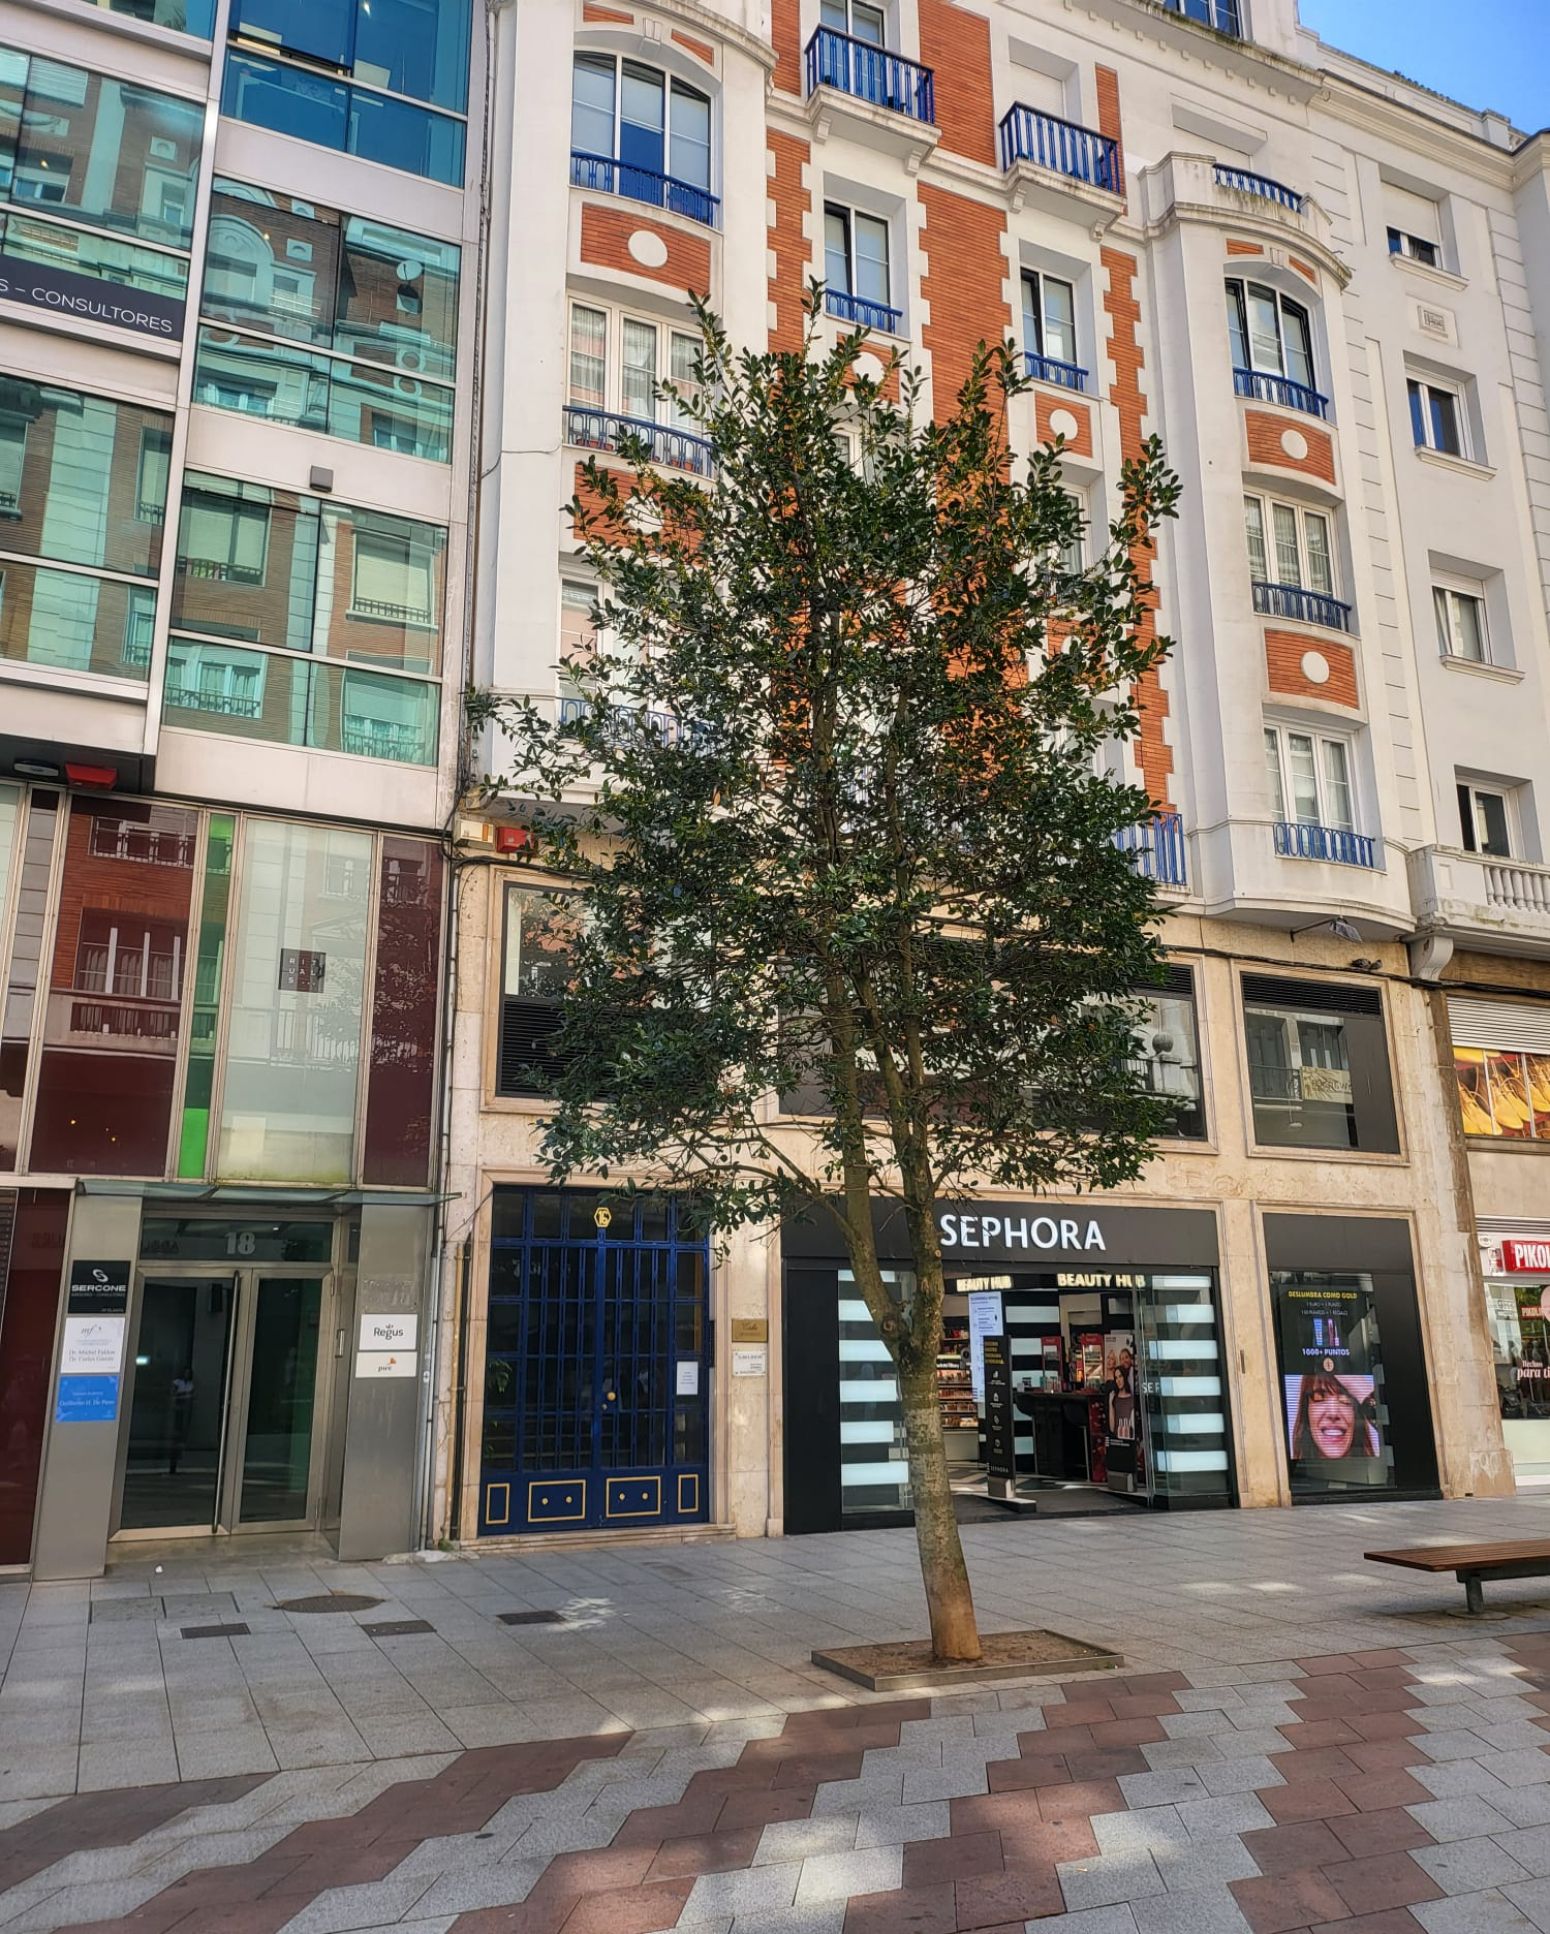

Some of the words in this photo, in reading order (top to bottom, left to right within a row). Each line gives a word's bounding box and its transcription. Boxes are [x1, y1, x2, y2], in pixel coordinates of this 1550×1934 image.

[32, 287, 172, 332] CONSULTORES
[940, 1214, 1106, 1250] SEPHORA
[224, 1231, 256, 1255] 18
[71, 1284, 127, 1292] SERCONE
[956, 1277, 989, 1292] BEAUTY
[990, 1275, 1012, 1289] HUB
[1057, 1273, 1112, 1287] BEAUTY
[1115, 1274, 1146, 1288] HUB
[1323, 1291, 1340, 1299] COMO
[373, 1327, 404, 1340] Regus
[1516, 1367, 1541, 1381] para
